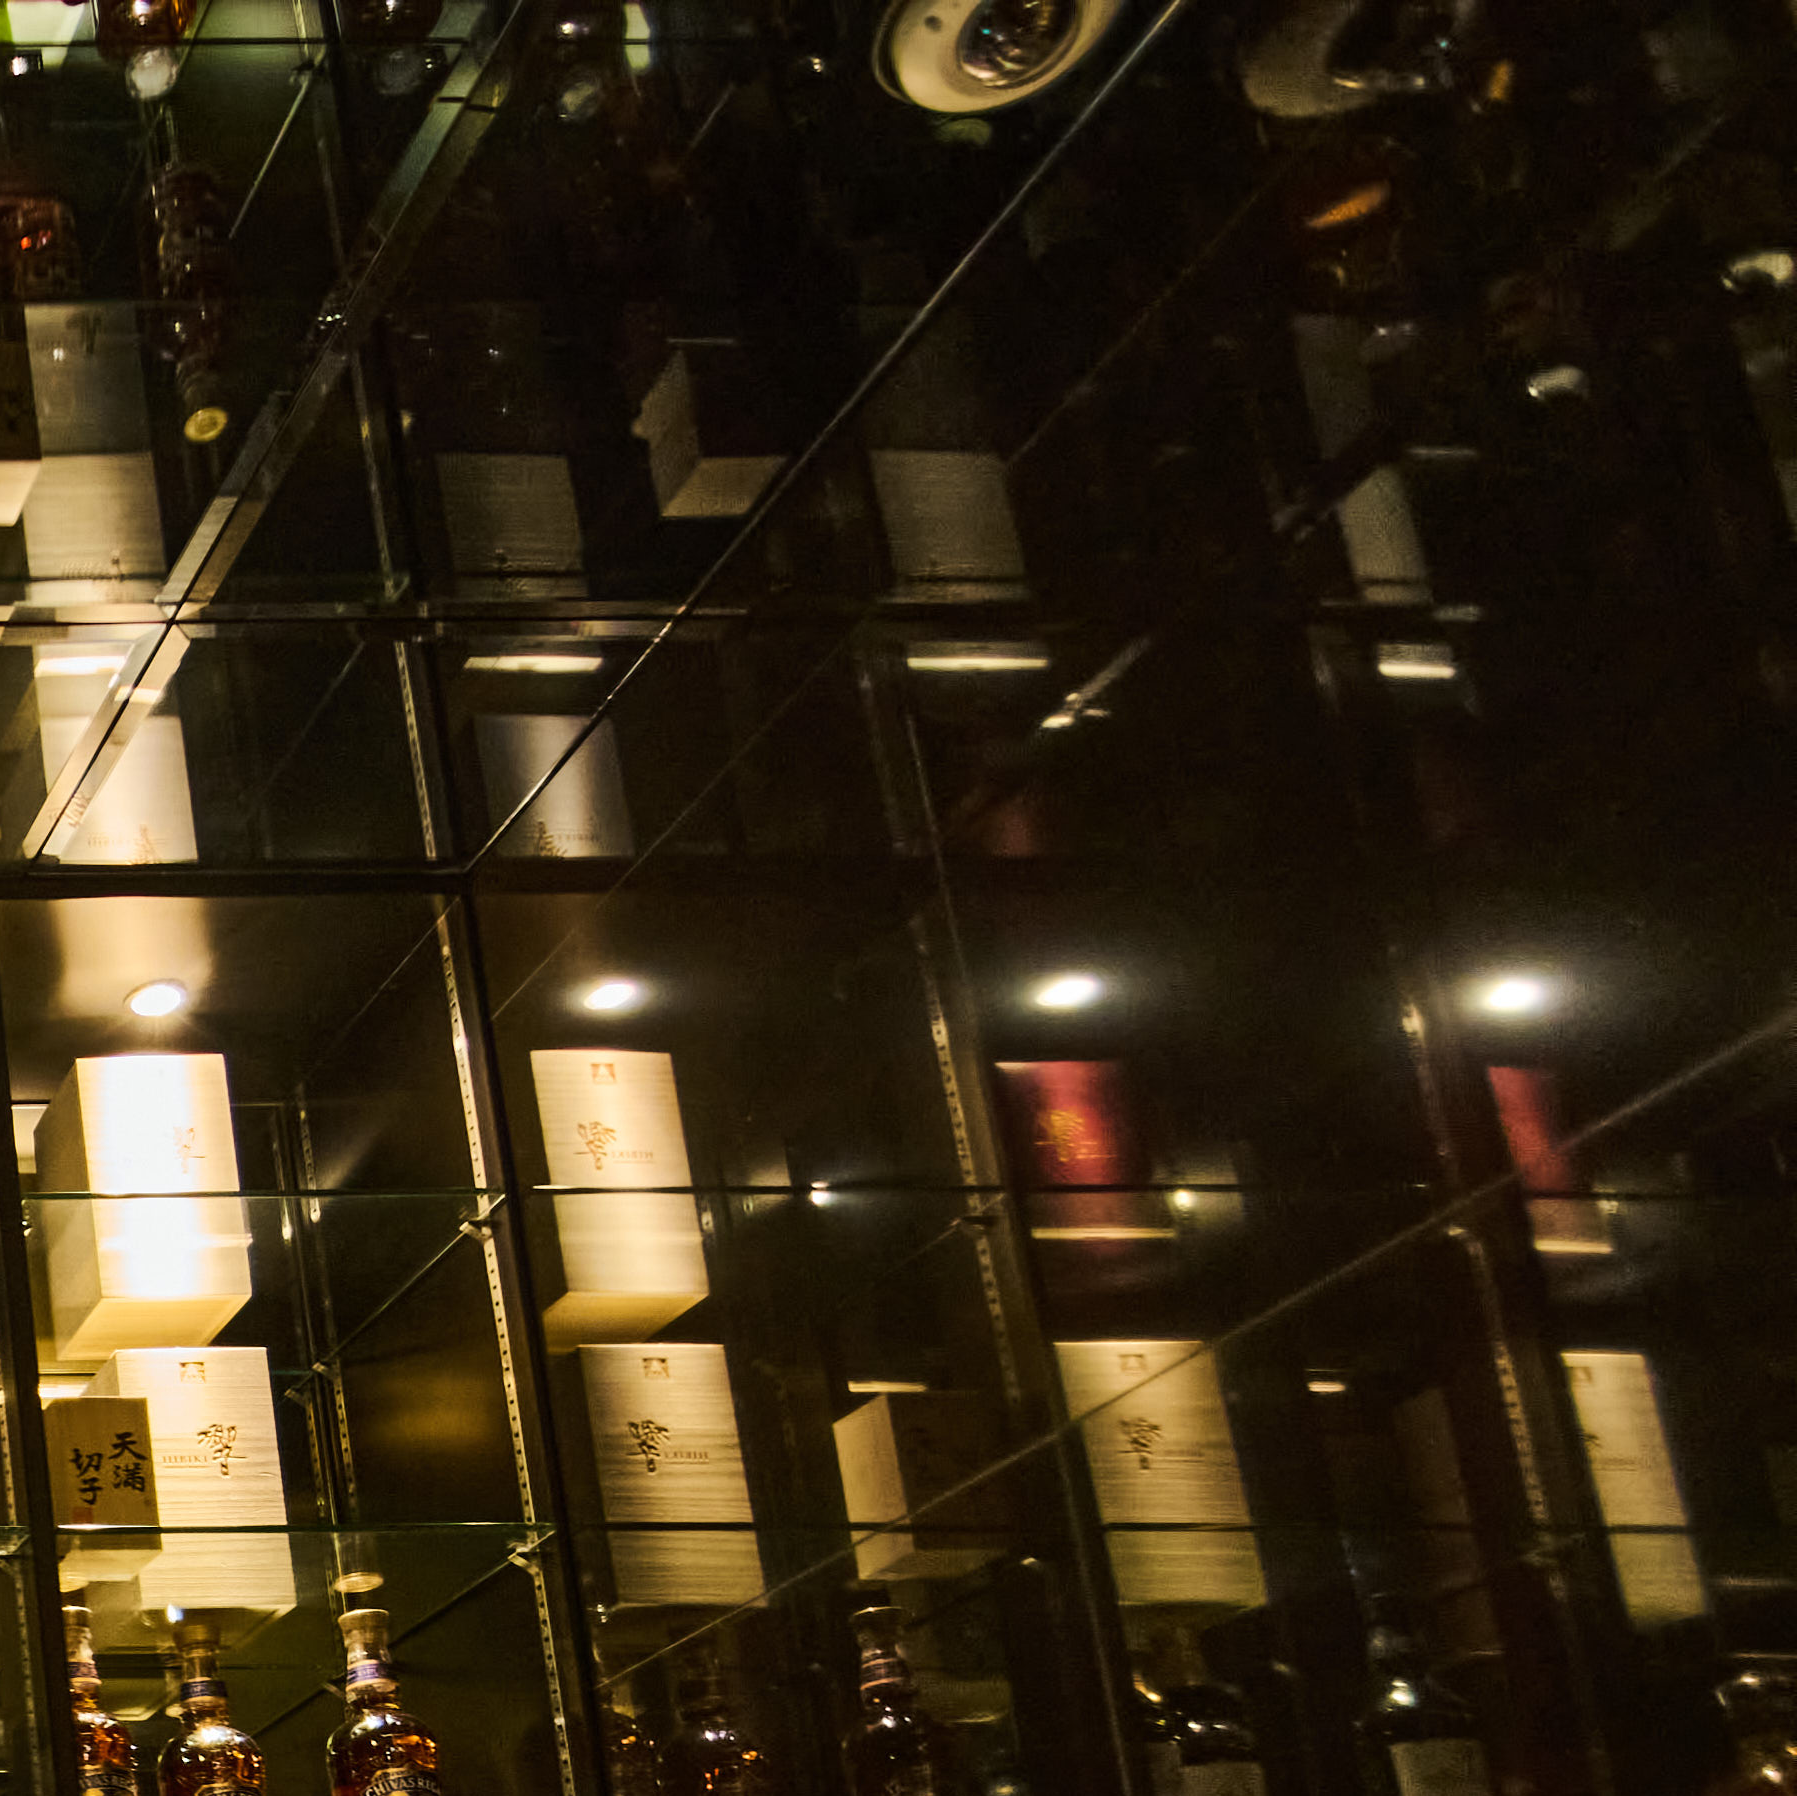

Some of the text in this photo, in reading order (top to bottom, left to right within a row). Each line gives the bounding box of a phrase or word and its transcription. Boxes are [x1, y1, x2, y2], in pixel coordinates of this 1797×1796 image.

[69, 1448, 104, 1505] 切子
[108, 1432, 149, 1493] 天満
[197, 1423, 247, 1476] 響
